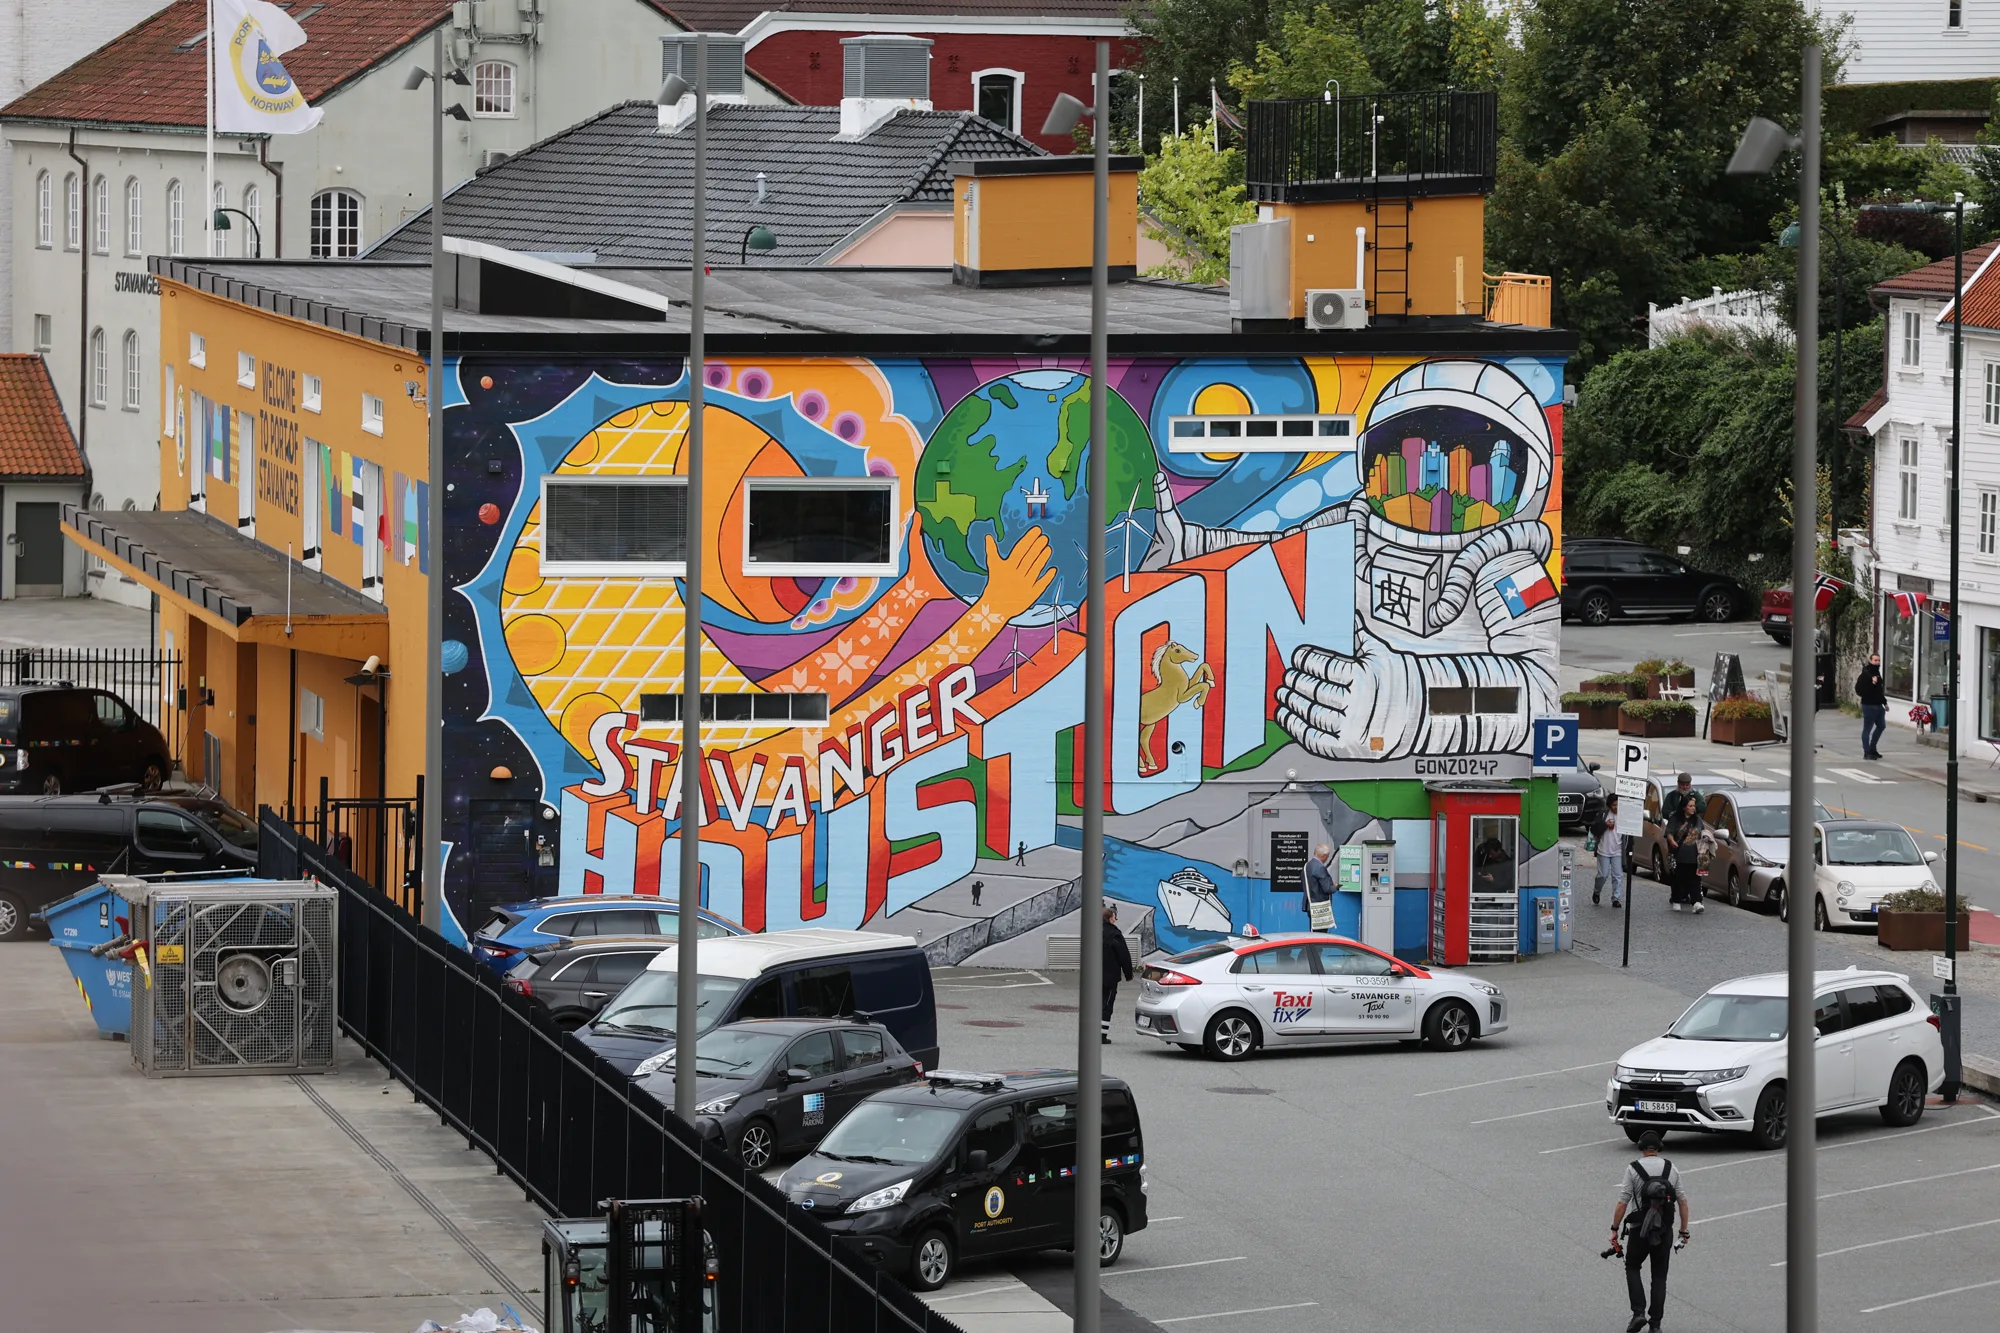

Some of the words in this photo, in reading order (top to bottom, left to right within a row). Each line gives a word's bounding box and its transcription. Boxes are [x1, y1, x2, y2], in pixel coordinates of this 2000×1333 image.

[234, 17, 253, 46] POR
[250, 95, 295, 112] NORWAY
[261, 359, 296, 414] WELCOME
[259, 408, 269, 453] TO
[270, 413, 288, 462] PORT
[286, 420, 299, 466] OF
[259, 457, 299, 518] STAVANGER
[558, 518, 1356, 934] HOUSTON
[1546, 725, 1566, 749] P
[581, 663, 988, 832] STAVANGER
[1624, 744, 1642, 772] P
[1414, 758, 1499, 776] GONZO247
[1630, 780, 1644, 789] avgift
[116, 970, 132, 982] WES
[1355, 976, 1390, 986] RO-3591
[1272, 991, 1313, 1008] Taxi
[1350, 992, 1400, 1000] STAVANGER
[1272, 1007, 1294, 1023] fix
[1362, 1000, 1386, 1013] Taxi
[1640, 1102, 1649, 1110] RL
[1652, 1102, 1675, 1111] 58458
[802, 1118, 824, 1127] PARKING
[987, 1216, 1014, 1226] AUTHORITY
